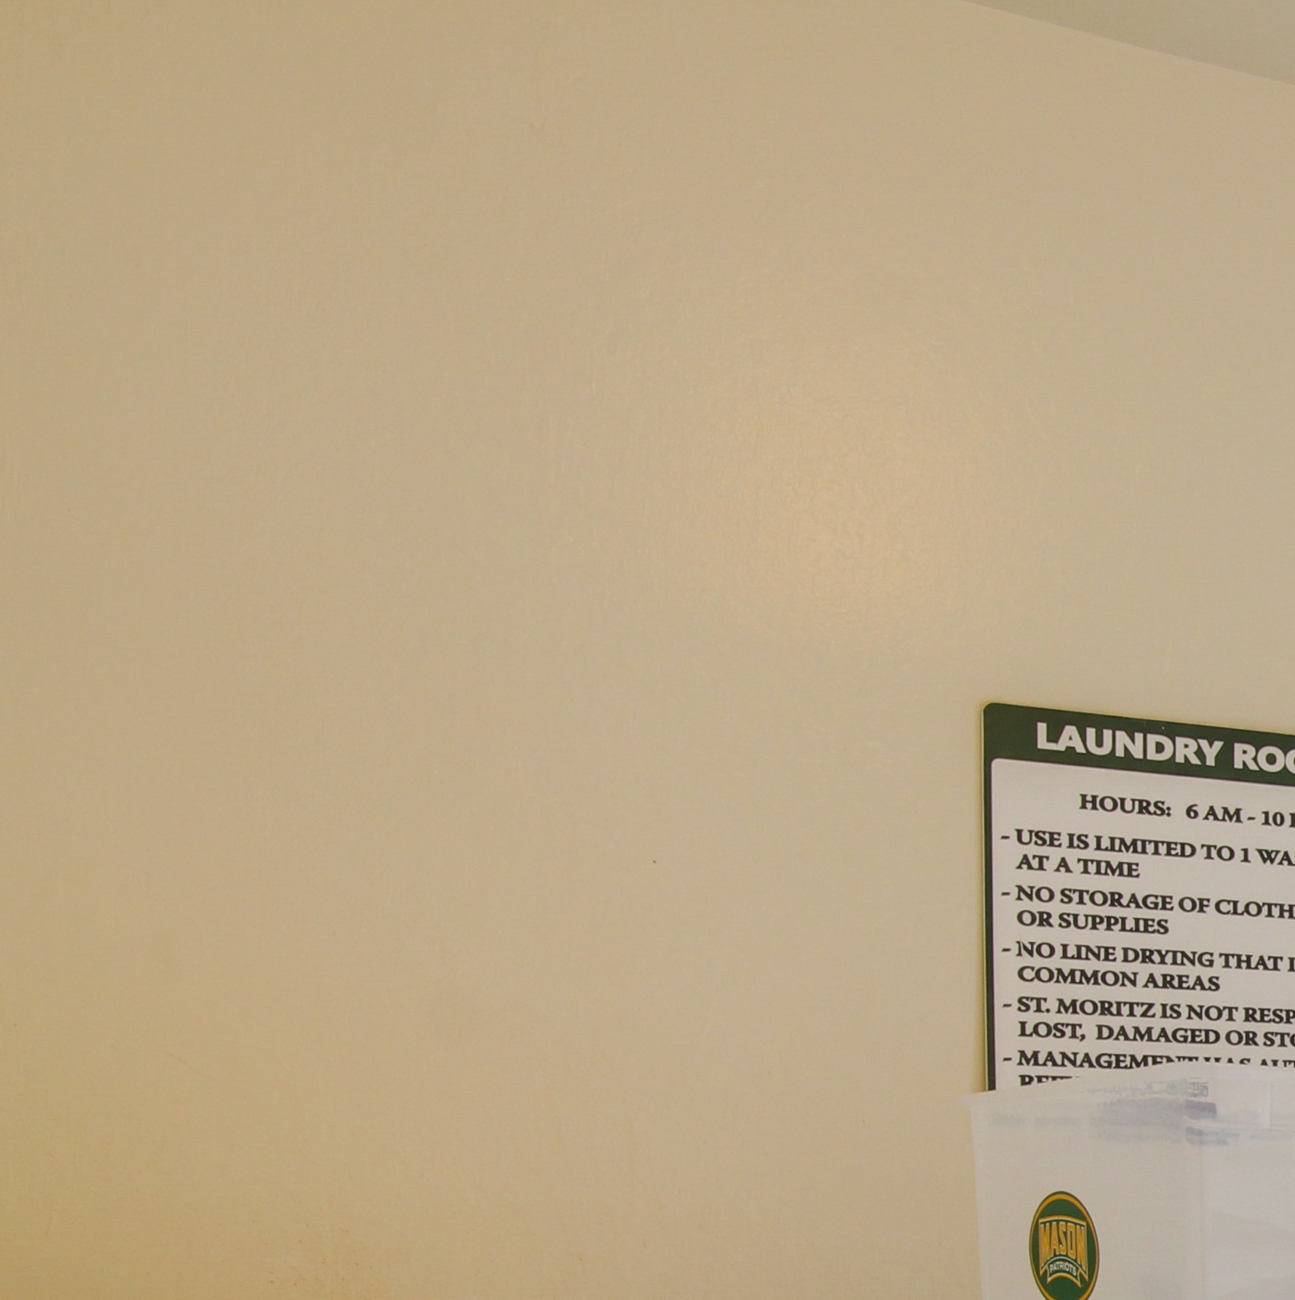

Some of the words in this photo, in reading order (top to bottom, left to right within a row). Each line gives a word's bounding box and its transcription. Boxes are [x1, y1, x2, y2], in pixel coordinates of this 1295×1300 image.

[1036, 722, 1223, 767] LAUNDRY
[1079, 794, 1172, 818] HOURS:
[1185, 804, 1198, 820] 6
[1203, 806, 1243, 823] AM
[1262, 811, 1285, 827] 10
[1016, 829, 1062, 848] USE
[1067, 834, 1090, 851] IS
[1094, 835, 1196, 858] LIMITED
[1202, 844, 1235, 862] TO
[1240, 848, 1251, 863] 1
[1017, 854, 1050, 871] AT
[1055, 858, 1072, 873] A
[1077, 858, 1140, 878] TIME
[1016, 885, 1055, 904] NO
[1060, 889, 1174, 912] STORAGE
[1178, 897, 1210, 914] OF
[1017, 911, 1054, 929] OR
[1059, 914, 1169, 935] SUPPLIES
[1017, 941, 1055, 959] NO
[1060, 944, 1117, 963] LINE
[1122, 948, 1214, 968] DRYING
[1219, 953, 1283, 972] THAT
[1017, 966, 1139, 988] COMMON
[1144, 972, 1220, 992] AREAS
[1017, 997, 1051, 1015] ST.
[1056, 999, 1156, 1019] MORITZ
[1160, 1004, 1181, 1020] IS
[1186, 1005, 1238, 1023] NOT
[1018, 1021, 1086, 1042] LOST,
[1096, 1025, 1221, 1045] DAMAGED
[1225, 1030, 1259, 1047] OR
[1040, 1222, 1086, 1271] MASON
[1050, 1261, 1076, 1276] PATRIOTS
